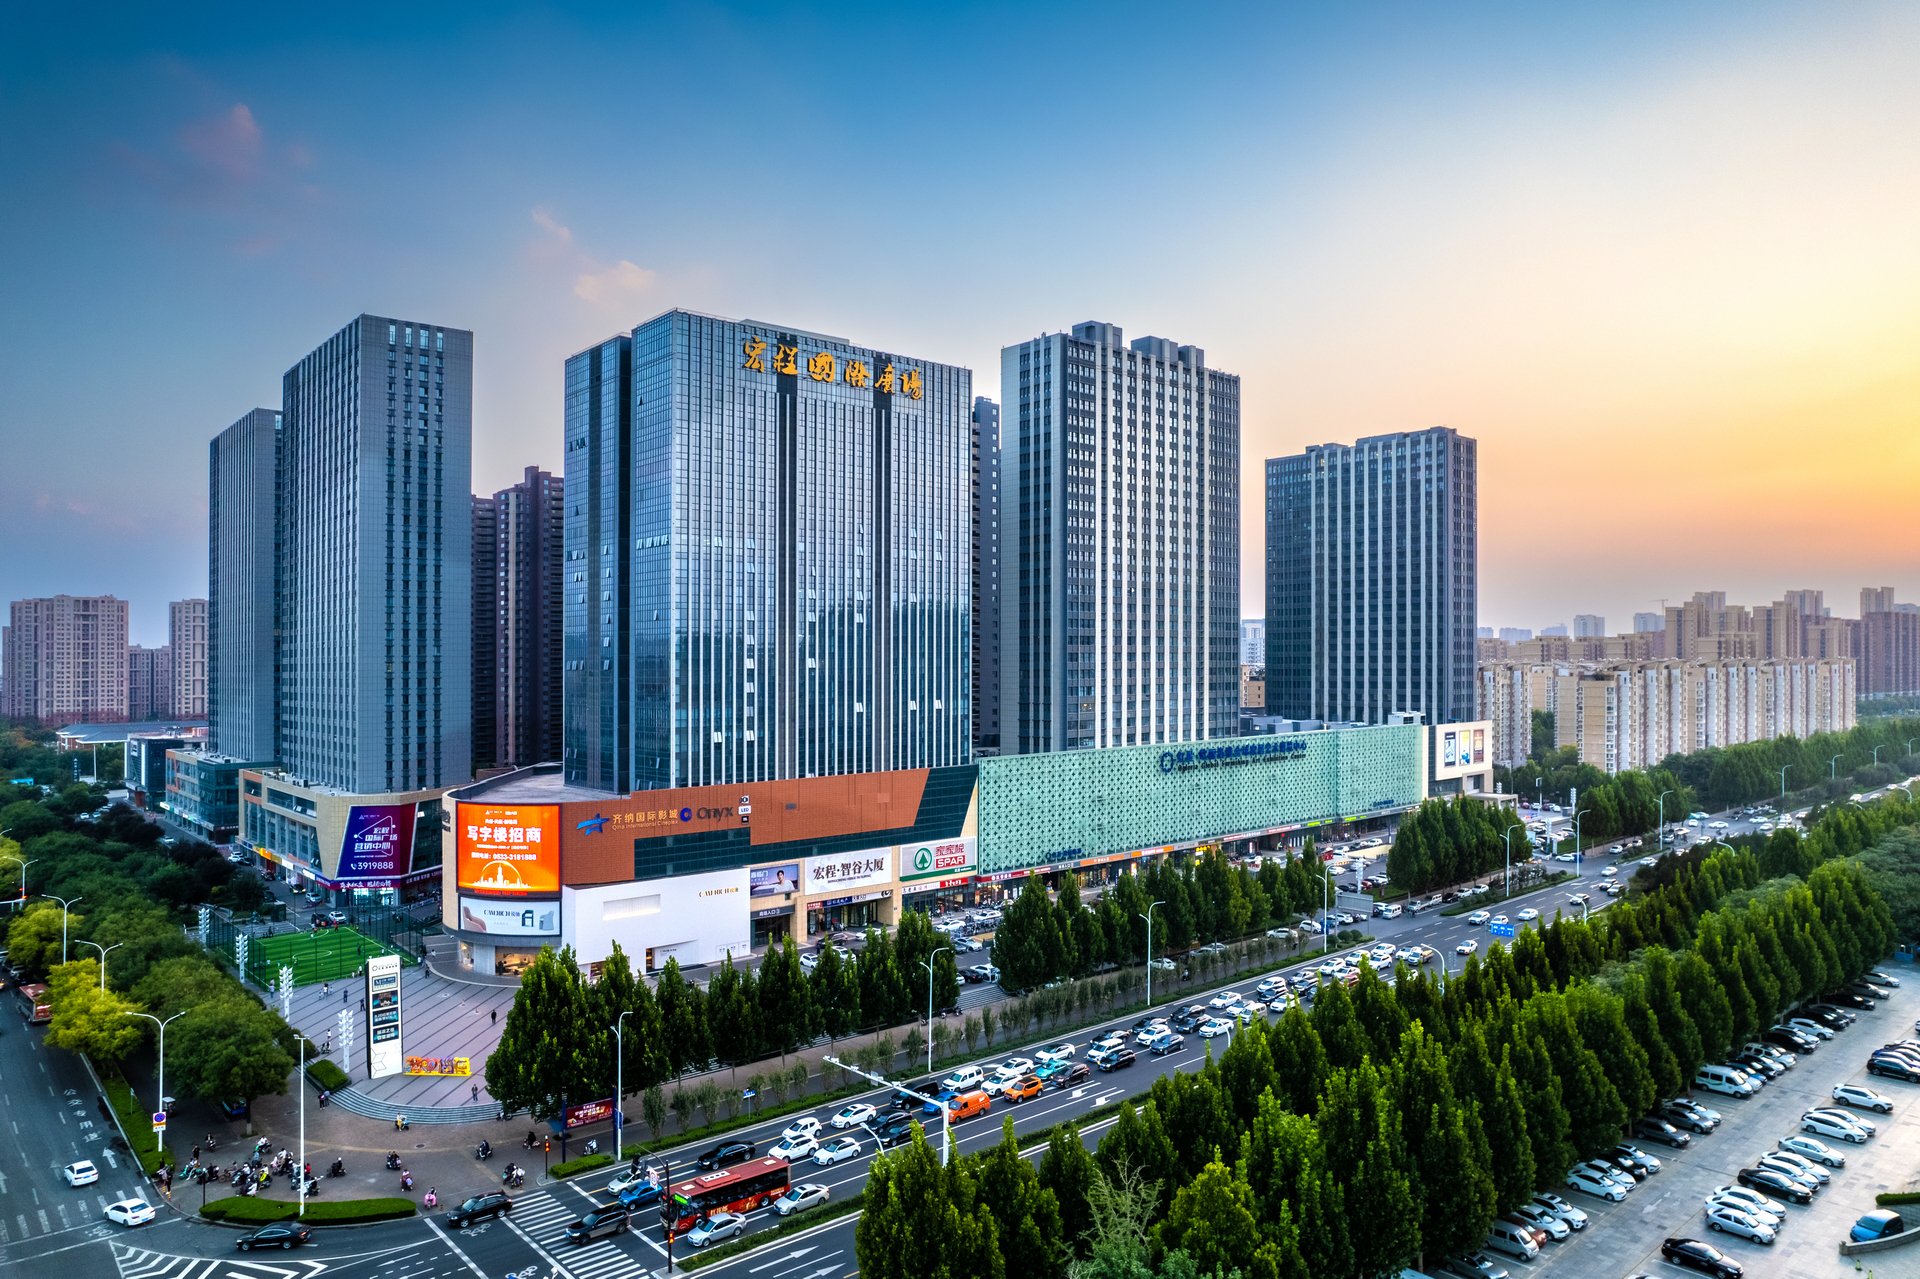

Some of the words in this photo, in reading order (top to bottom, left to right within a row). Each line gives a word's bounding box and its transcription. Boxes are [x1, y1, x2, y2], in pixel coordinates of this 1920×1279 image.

[612, 809, 678, 824] 齐纳国际影城
[697, 807, 733, 821] Onyx
[467, 826, 541, 843] 写字楼招商
[357, 861, 394, 870] 3919888
[813, 857, 884, 880] 宏程·智谷大厦
[937, 856, 964, 868] SPAR
